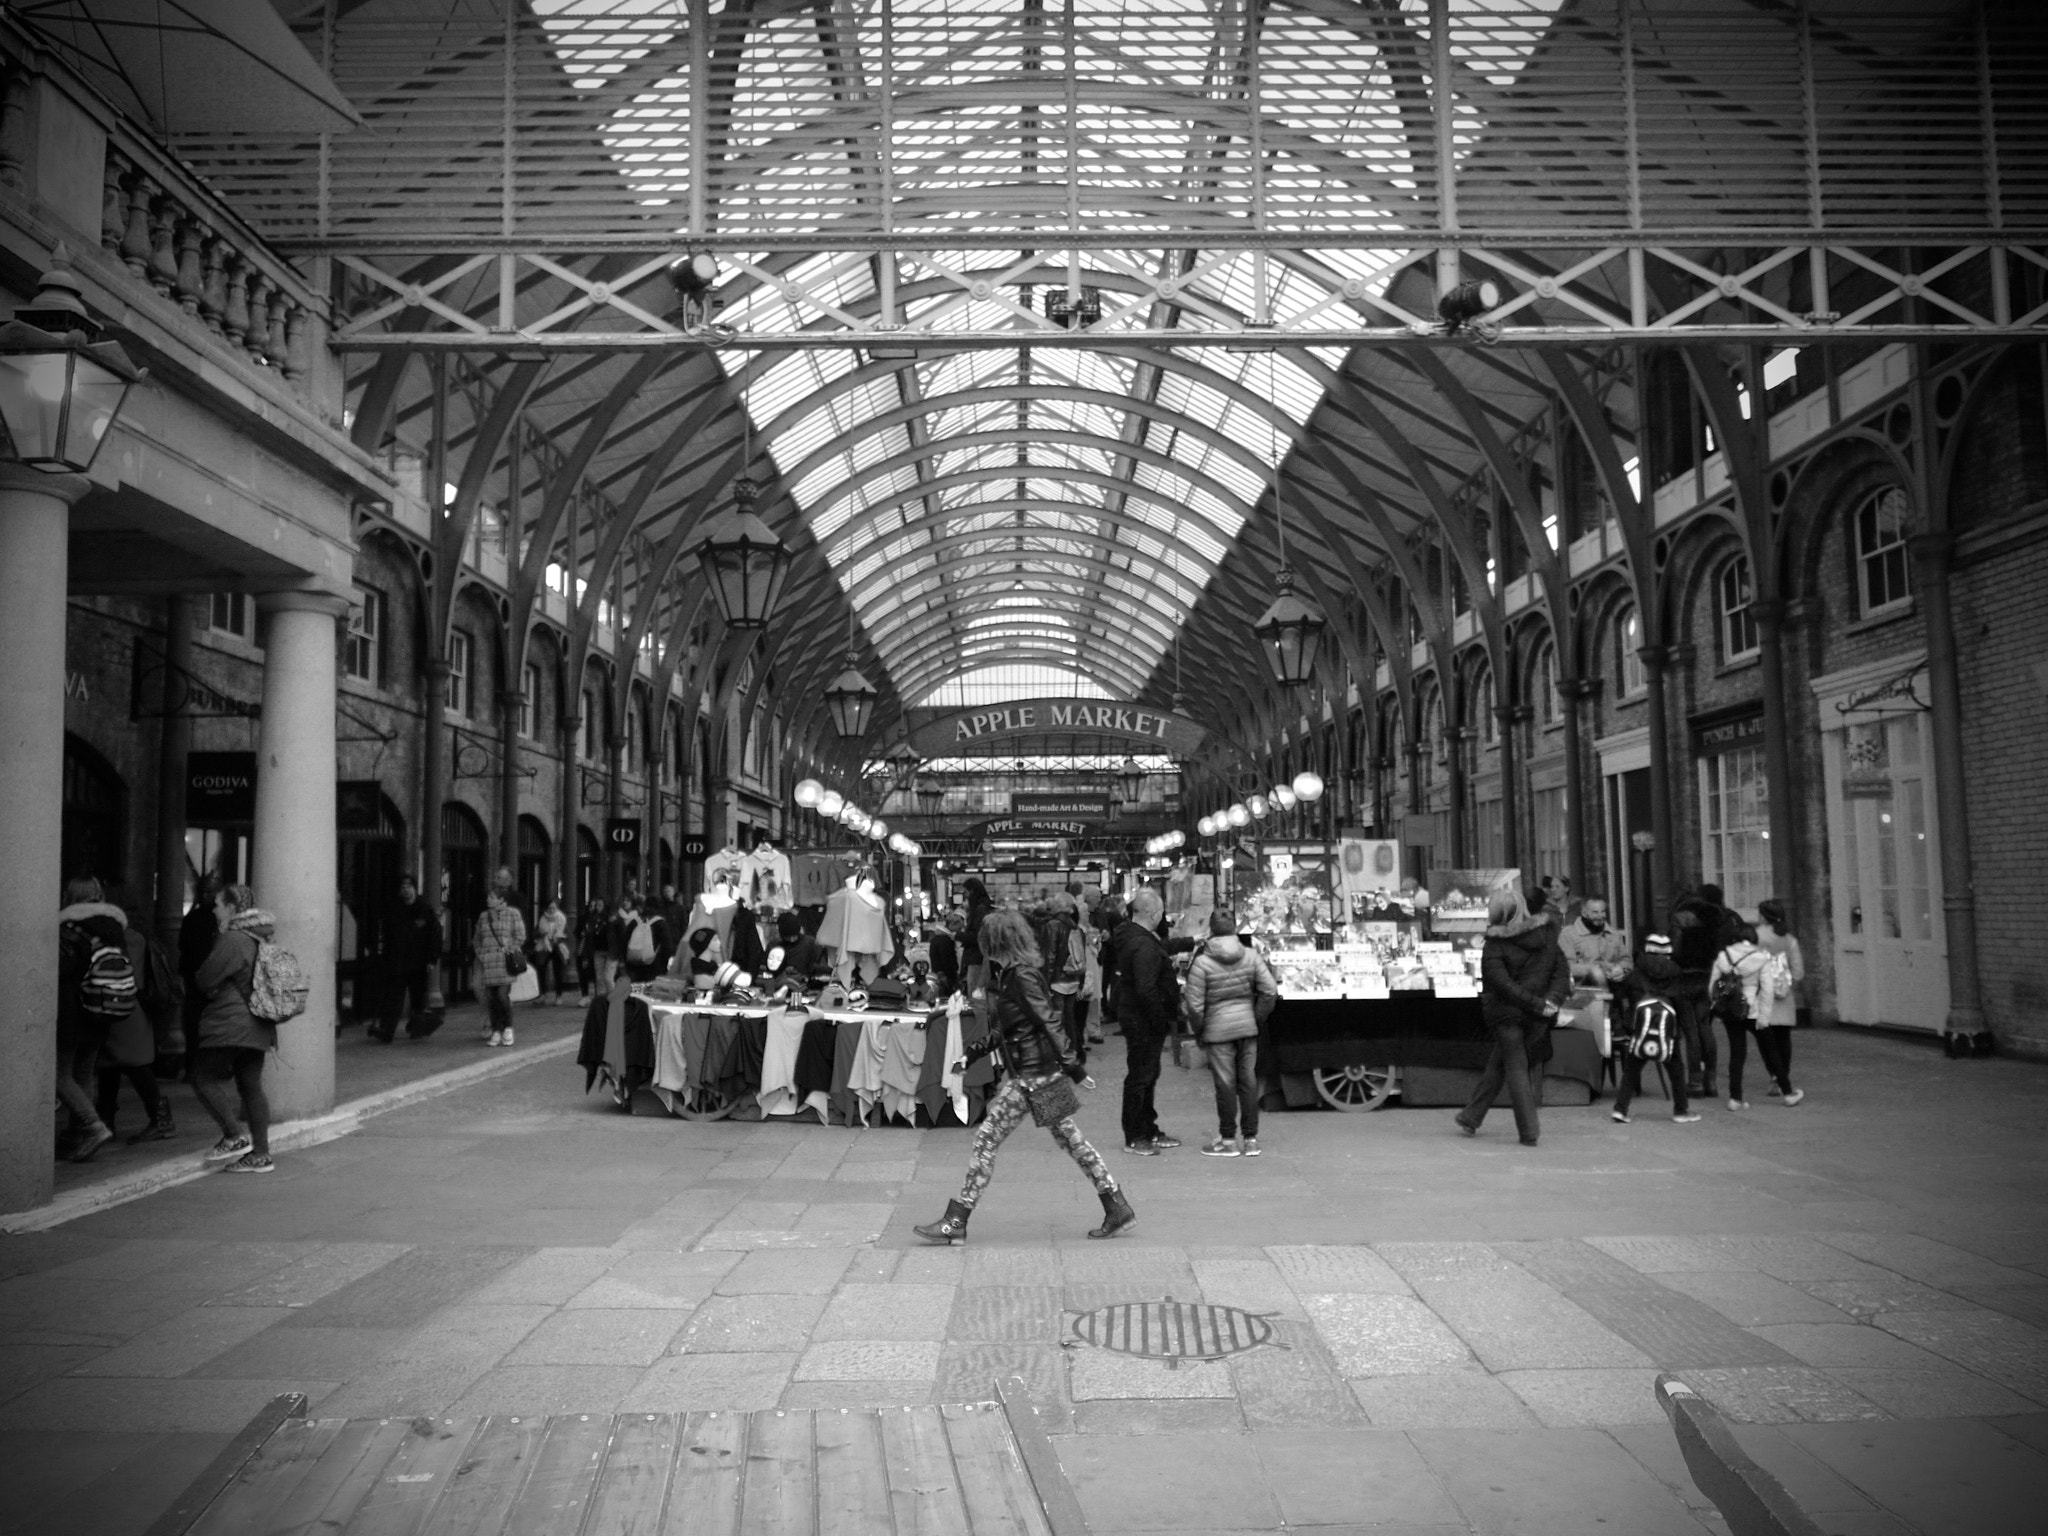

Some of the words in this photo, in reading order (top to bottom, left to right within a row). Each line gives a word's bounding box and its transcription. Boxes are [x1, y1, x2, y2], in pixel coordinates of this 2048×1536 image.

[955, 706, 1036, 741] APPLE
[1051, 705, 1171, 738] MARKET
[1702, 724, 1735, 746] PUNCH
[1738, 720, 1747, 737] &
[192, 775, 249, 788] GODIVA
[1018, 803, 1059, 812] Hand-made
[1060, 803, 1071, 812] Art
[1072, 803, 1079, 812] &
[1079, 803, 1104, 813] Design
[986, 820, 1023, 835] APPLE
[1031, 822, 1086, 835] MARKET
